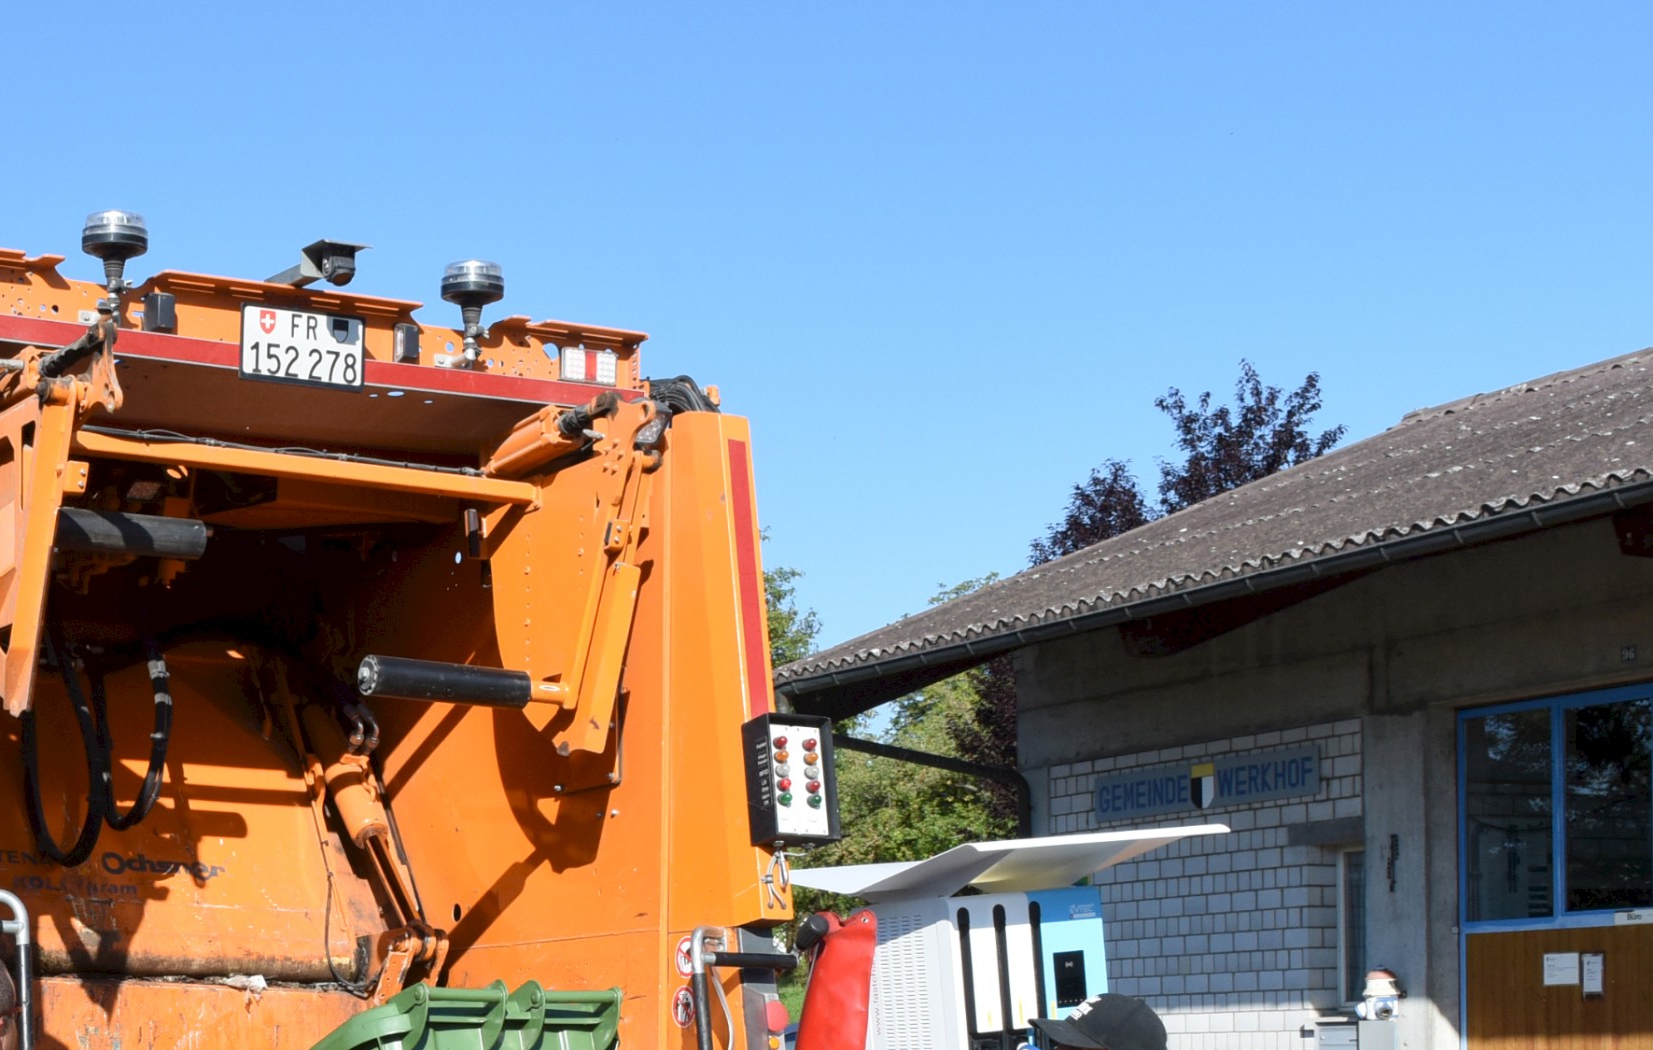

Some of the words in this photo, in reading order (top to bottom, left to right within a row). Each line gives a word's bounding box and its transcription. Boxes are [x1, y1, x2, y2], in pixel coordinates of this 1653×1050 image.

[291, 314, 318, 341] FR
[1099, 774, 1189, 813] GEMEINDE
[1217, 756, 1313, 798] WERKHOF
[101, 851, 226, 882] Ochsner
